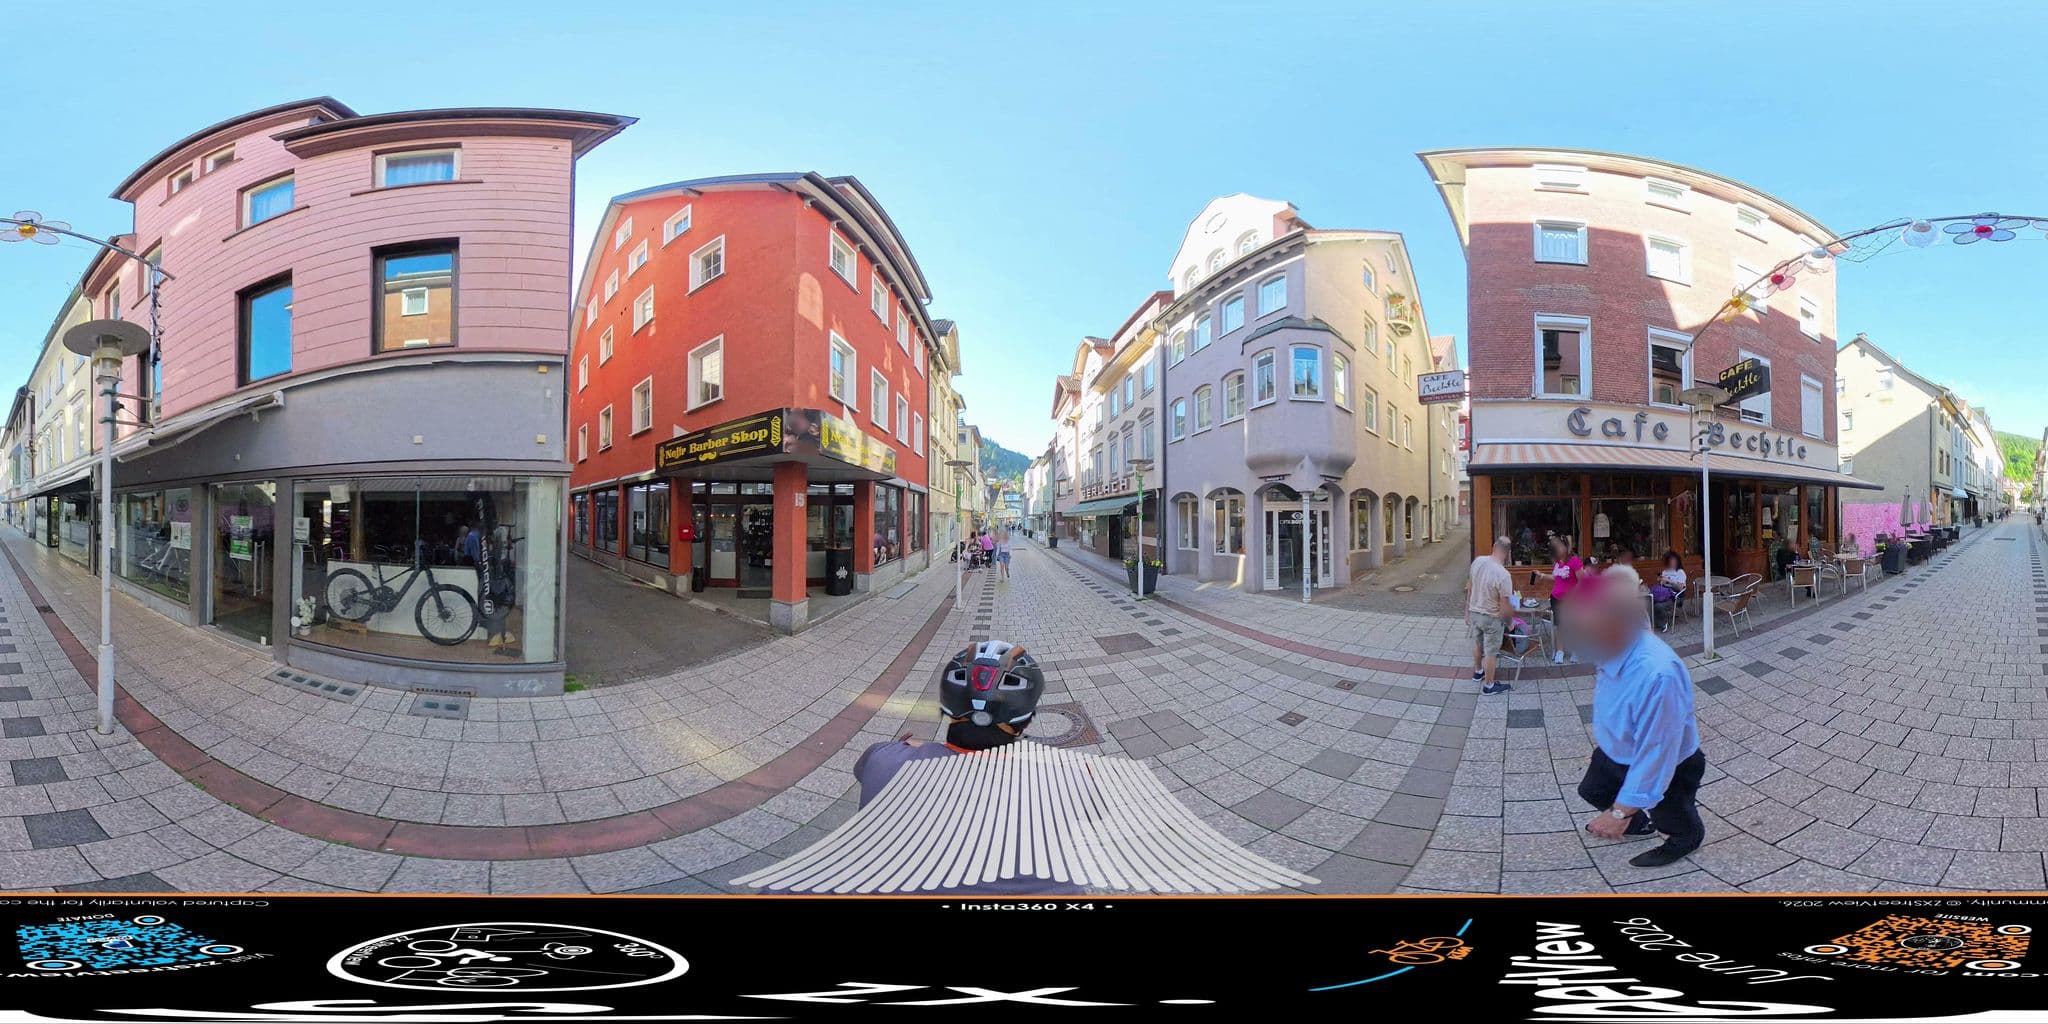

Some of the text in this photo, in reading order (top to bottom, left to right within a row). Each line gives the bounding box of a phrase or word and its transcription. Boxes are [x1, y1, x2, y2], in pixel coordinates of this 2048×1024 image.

[1423, 374, 1448, 383] CAFE
[1720, 360, 1753, 381] CAFE
[689, 437, 729, 453] Barber
[730, 428, 769, 444] Shop
[1567, 407, 1808, 459] Cafe Bechtle
